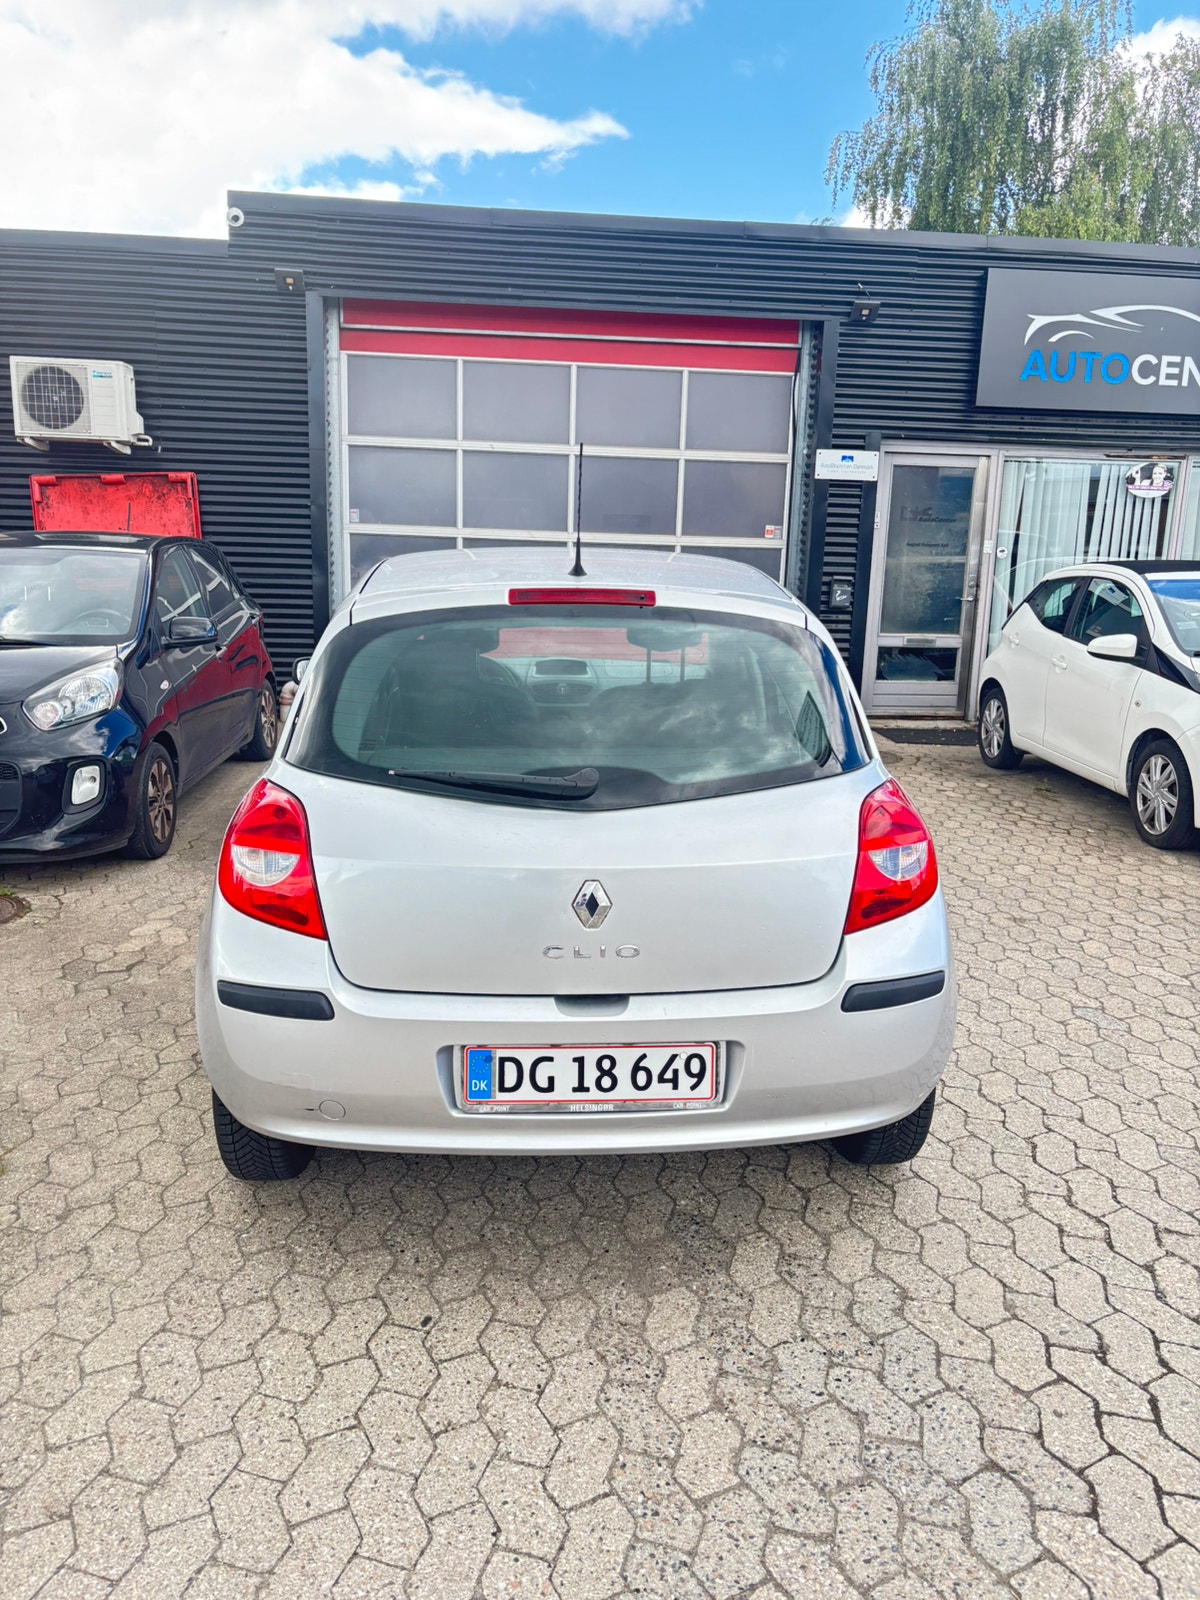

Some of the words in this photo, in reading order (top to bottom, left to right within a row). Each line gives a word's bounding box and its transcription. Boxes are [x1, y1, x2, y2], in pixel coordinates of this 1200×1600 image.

[542, 944, 640, 959] CLIO
[498, 1056, 555, 1093] DG
[571, 1055, 618, 1093] 18
[630, 1052, 707, 1092] 649
[471, 1079, 488, 1091] DK
